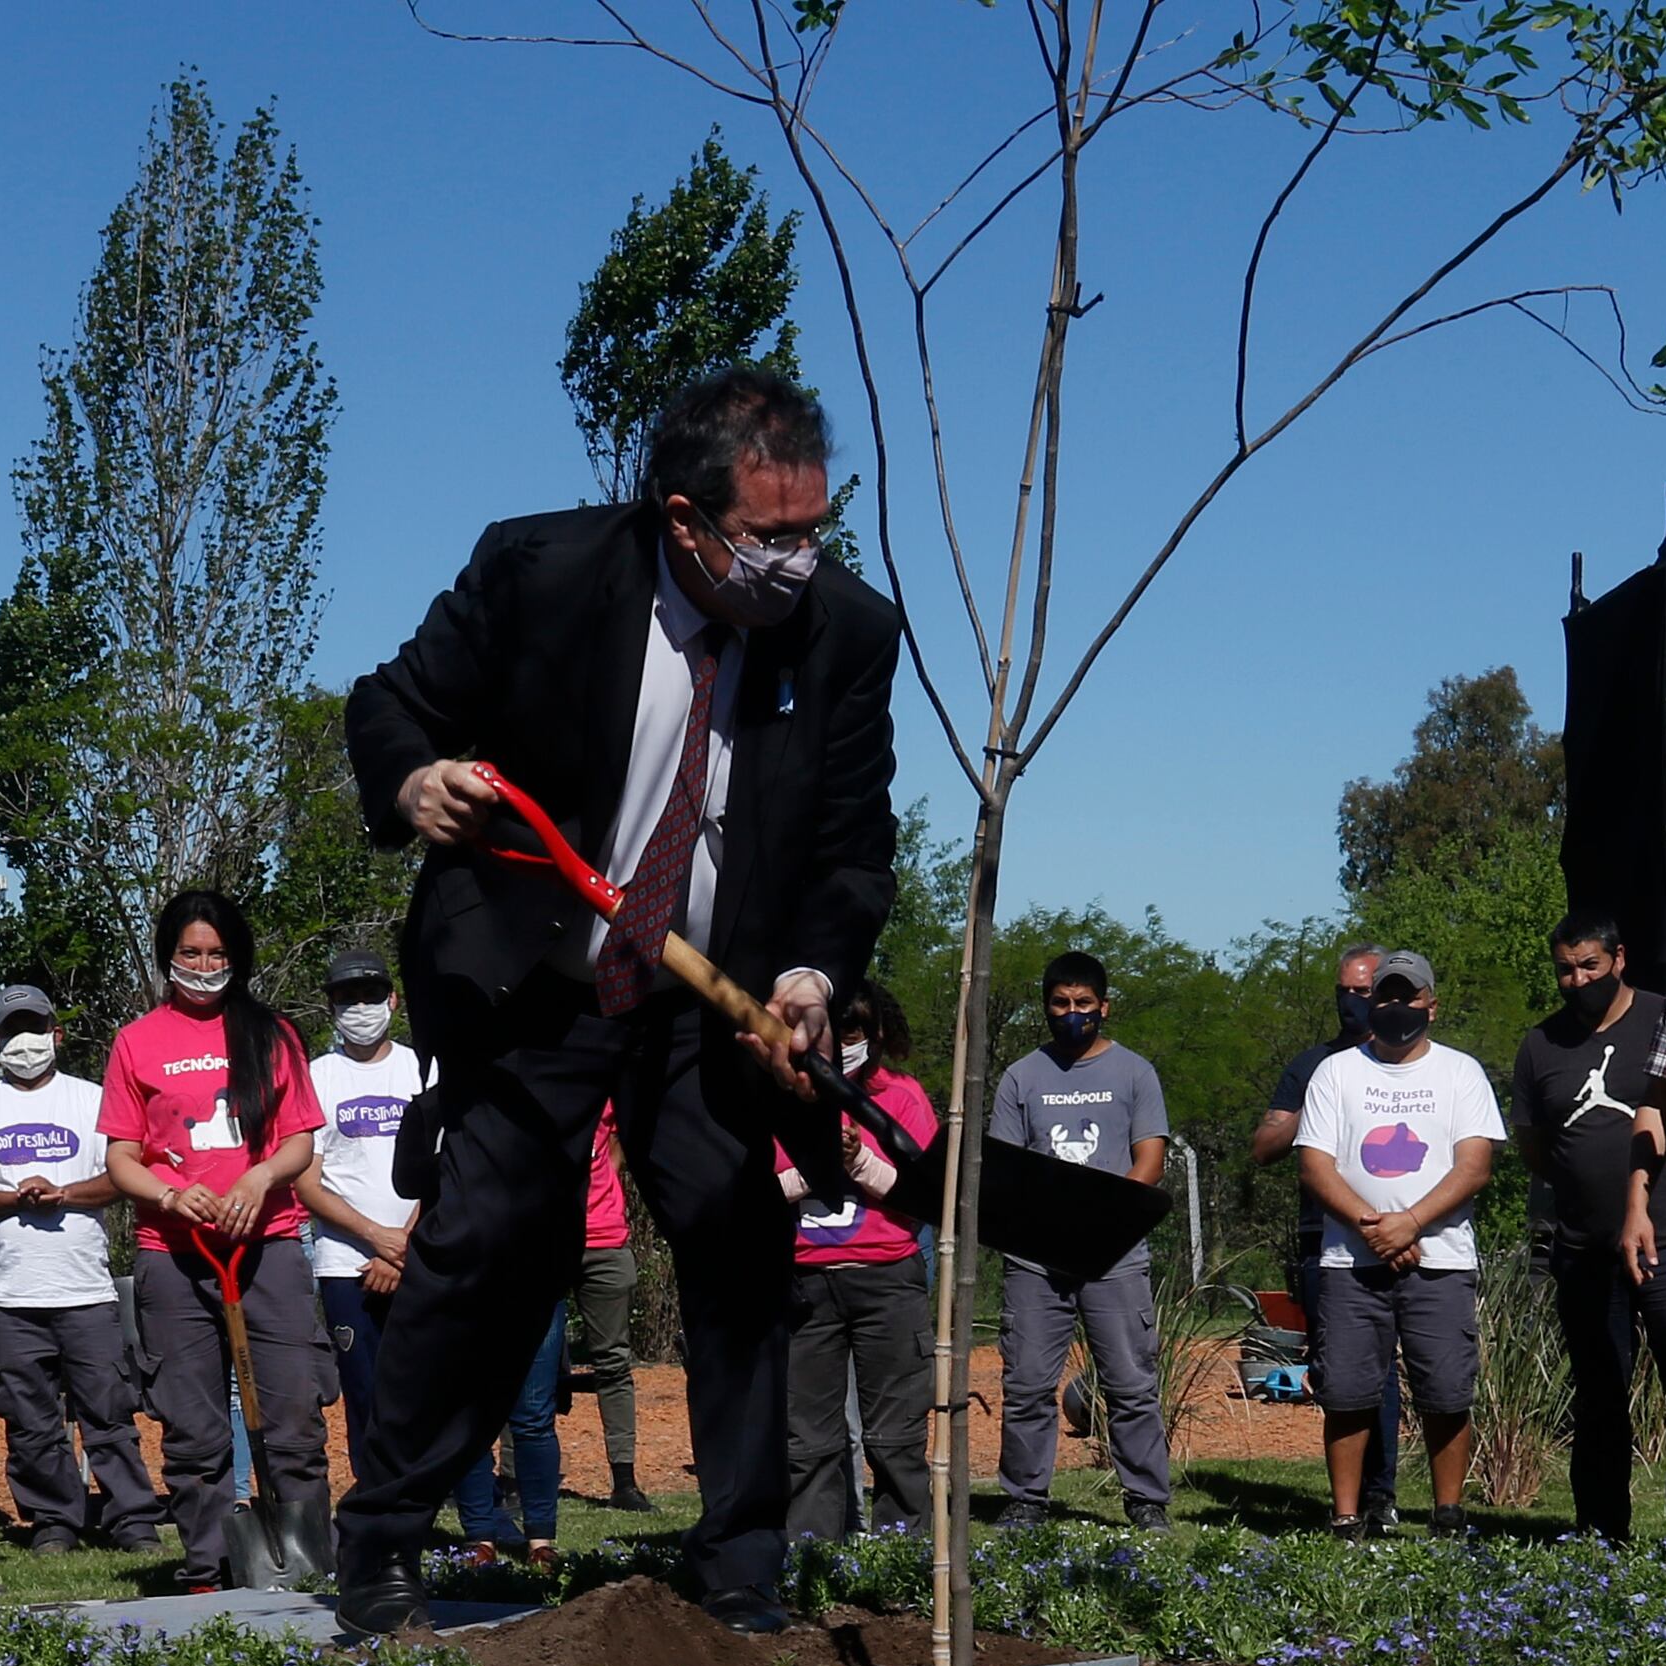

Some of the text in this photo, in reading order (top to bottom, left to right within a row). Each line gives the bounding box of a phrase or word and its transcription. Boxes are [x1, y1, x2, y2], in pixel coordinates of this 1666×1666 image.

[162, 1053, 230, 1076] TECNÓP
[1041, 1091, 1113, 1105] TECNÓPOLIS
[1365, 1086, 1433, 1102] Me gusta
[338, 1105, 358, 1123] SOY
[1364, 1101, 1436, 1114] ayudarte!
